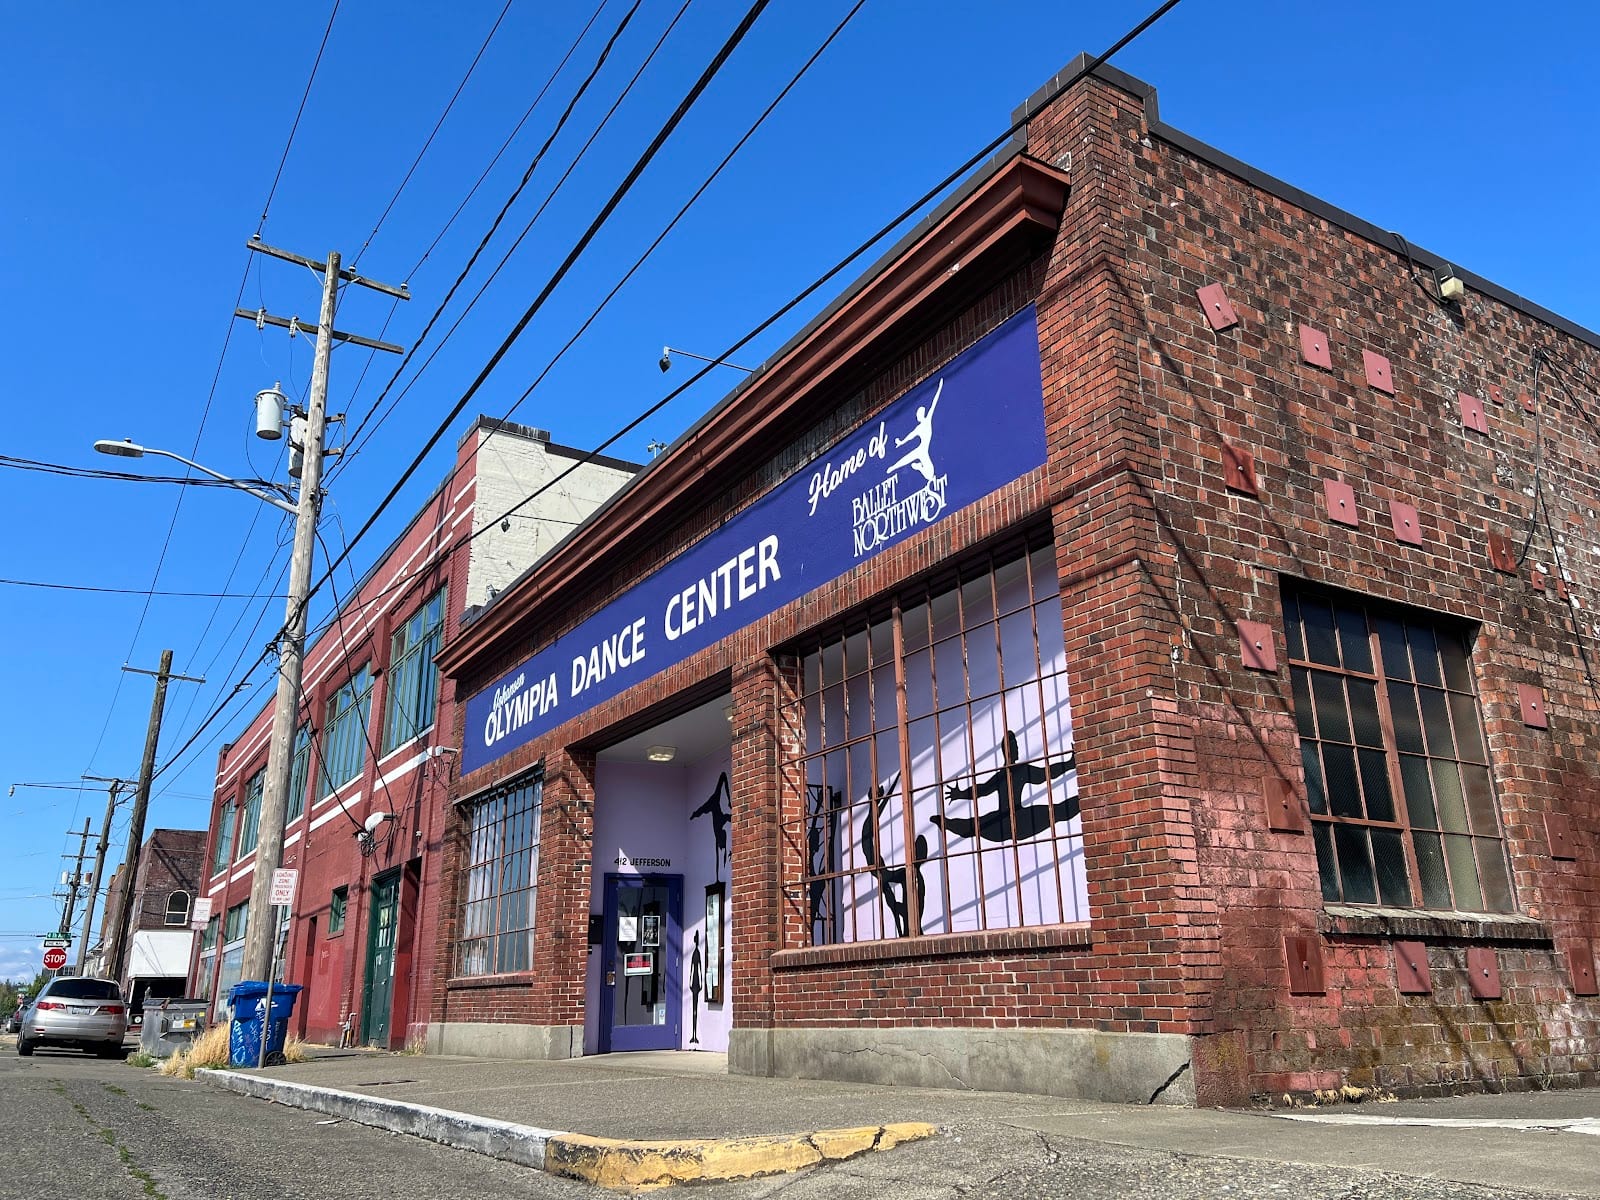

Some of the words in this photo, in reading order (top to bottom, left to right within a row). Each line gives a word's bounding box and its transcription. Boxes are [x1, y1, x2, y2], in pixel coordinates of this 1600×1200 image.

[808, 462, 867, 517] Home
[868, 421, 888, 459] of
[852, 473, 899, 527] BALLET
[853, 473, 948, 557] NORTHWEST
[484, 672, 558, 747] OLYMPIA
[571, 616, 646, 697] DANCE
[664, 535, 782, 640] CENTER
[493, 672, 525, 714] Johansen
[614, 857, 627, 866] 412
[630, 857, 671, 867] JEFFERSON
[44, 954, 66, 963] STOP
